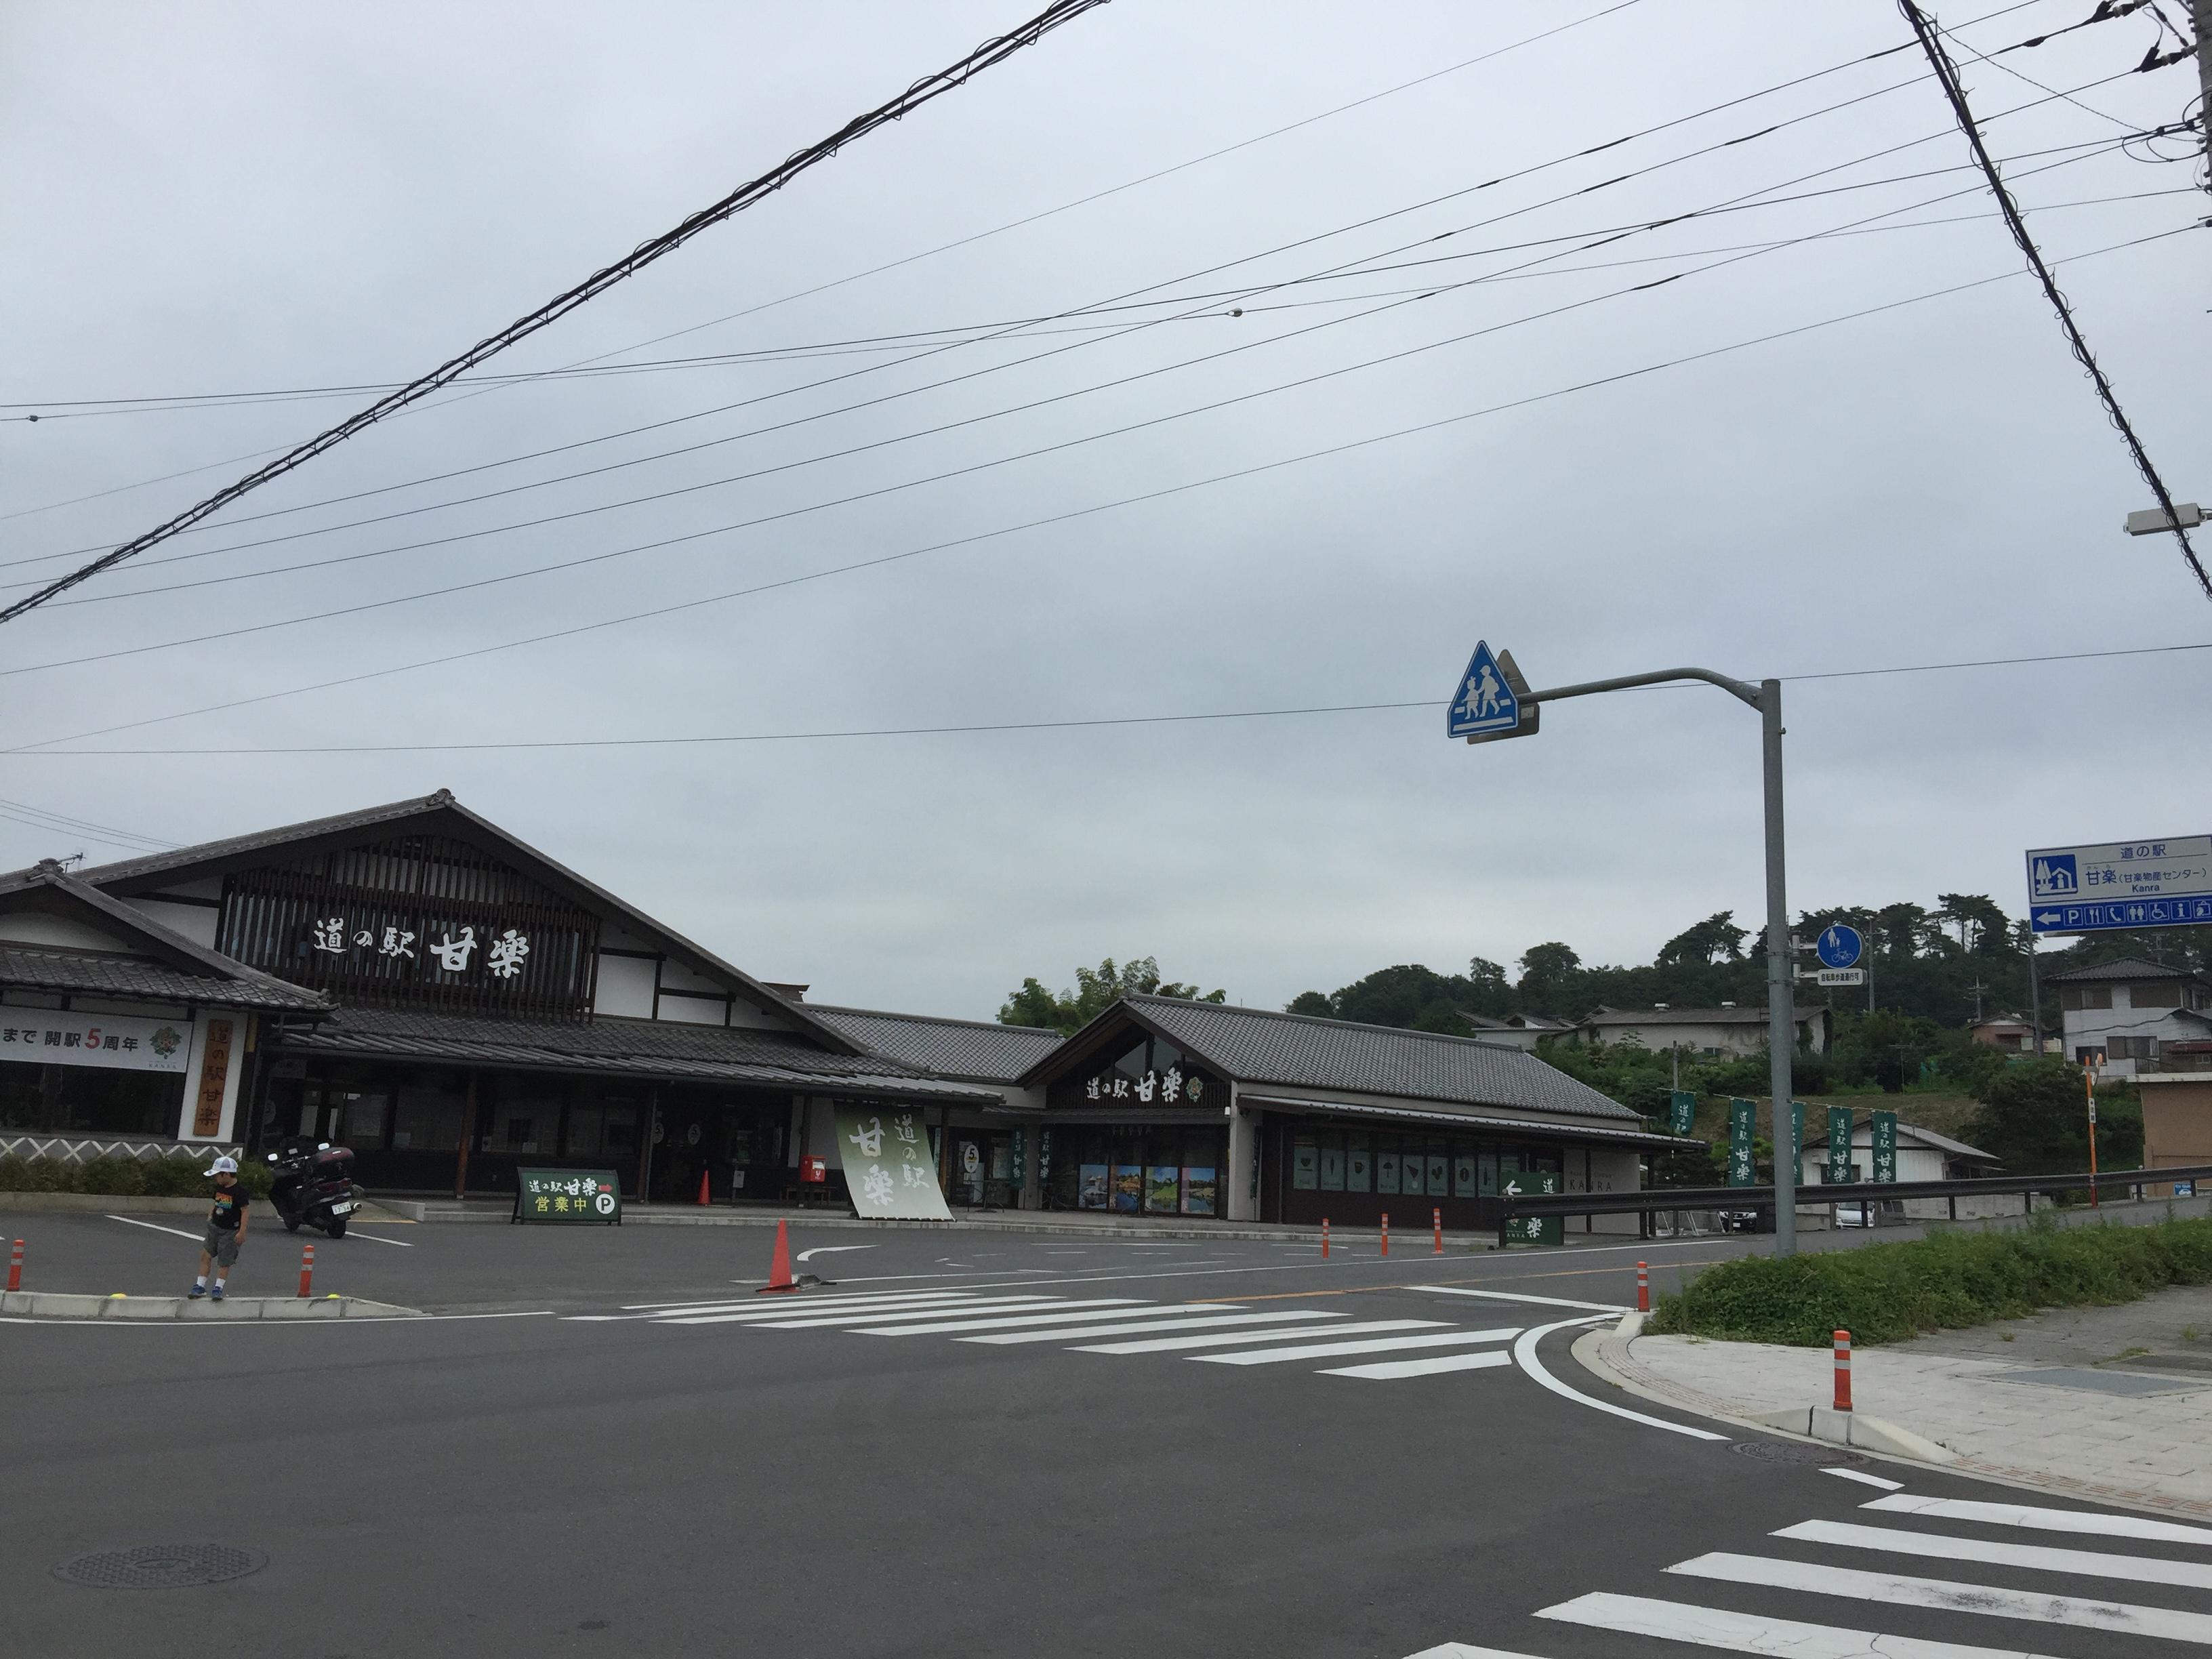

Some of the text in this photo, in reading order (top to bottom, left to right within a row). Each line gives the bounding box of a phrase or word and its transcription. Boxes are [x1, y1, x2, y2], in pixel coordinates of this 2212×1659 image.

[2121, 844, 2167, 859] 道の駅
[2085, 869, 2118, 886] 甘楽
[2132, 884, 2160, 893] Kanra
[44, 1027, 139, 1052] 開駅5周年
[894, 1113, 930, 1188] 道の駅
[968, 1148, 975, 1160] 5
[848, 1117, 895, 1206] 甘楽
[535, 1196, 587, 1212] 営業中
[600, 1197, 610, 1211] P
